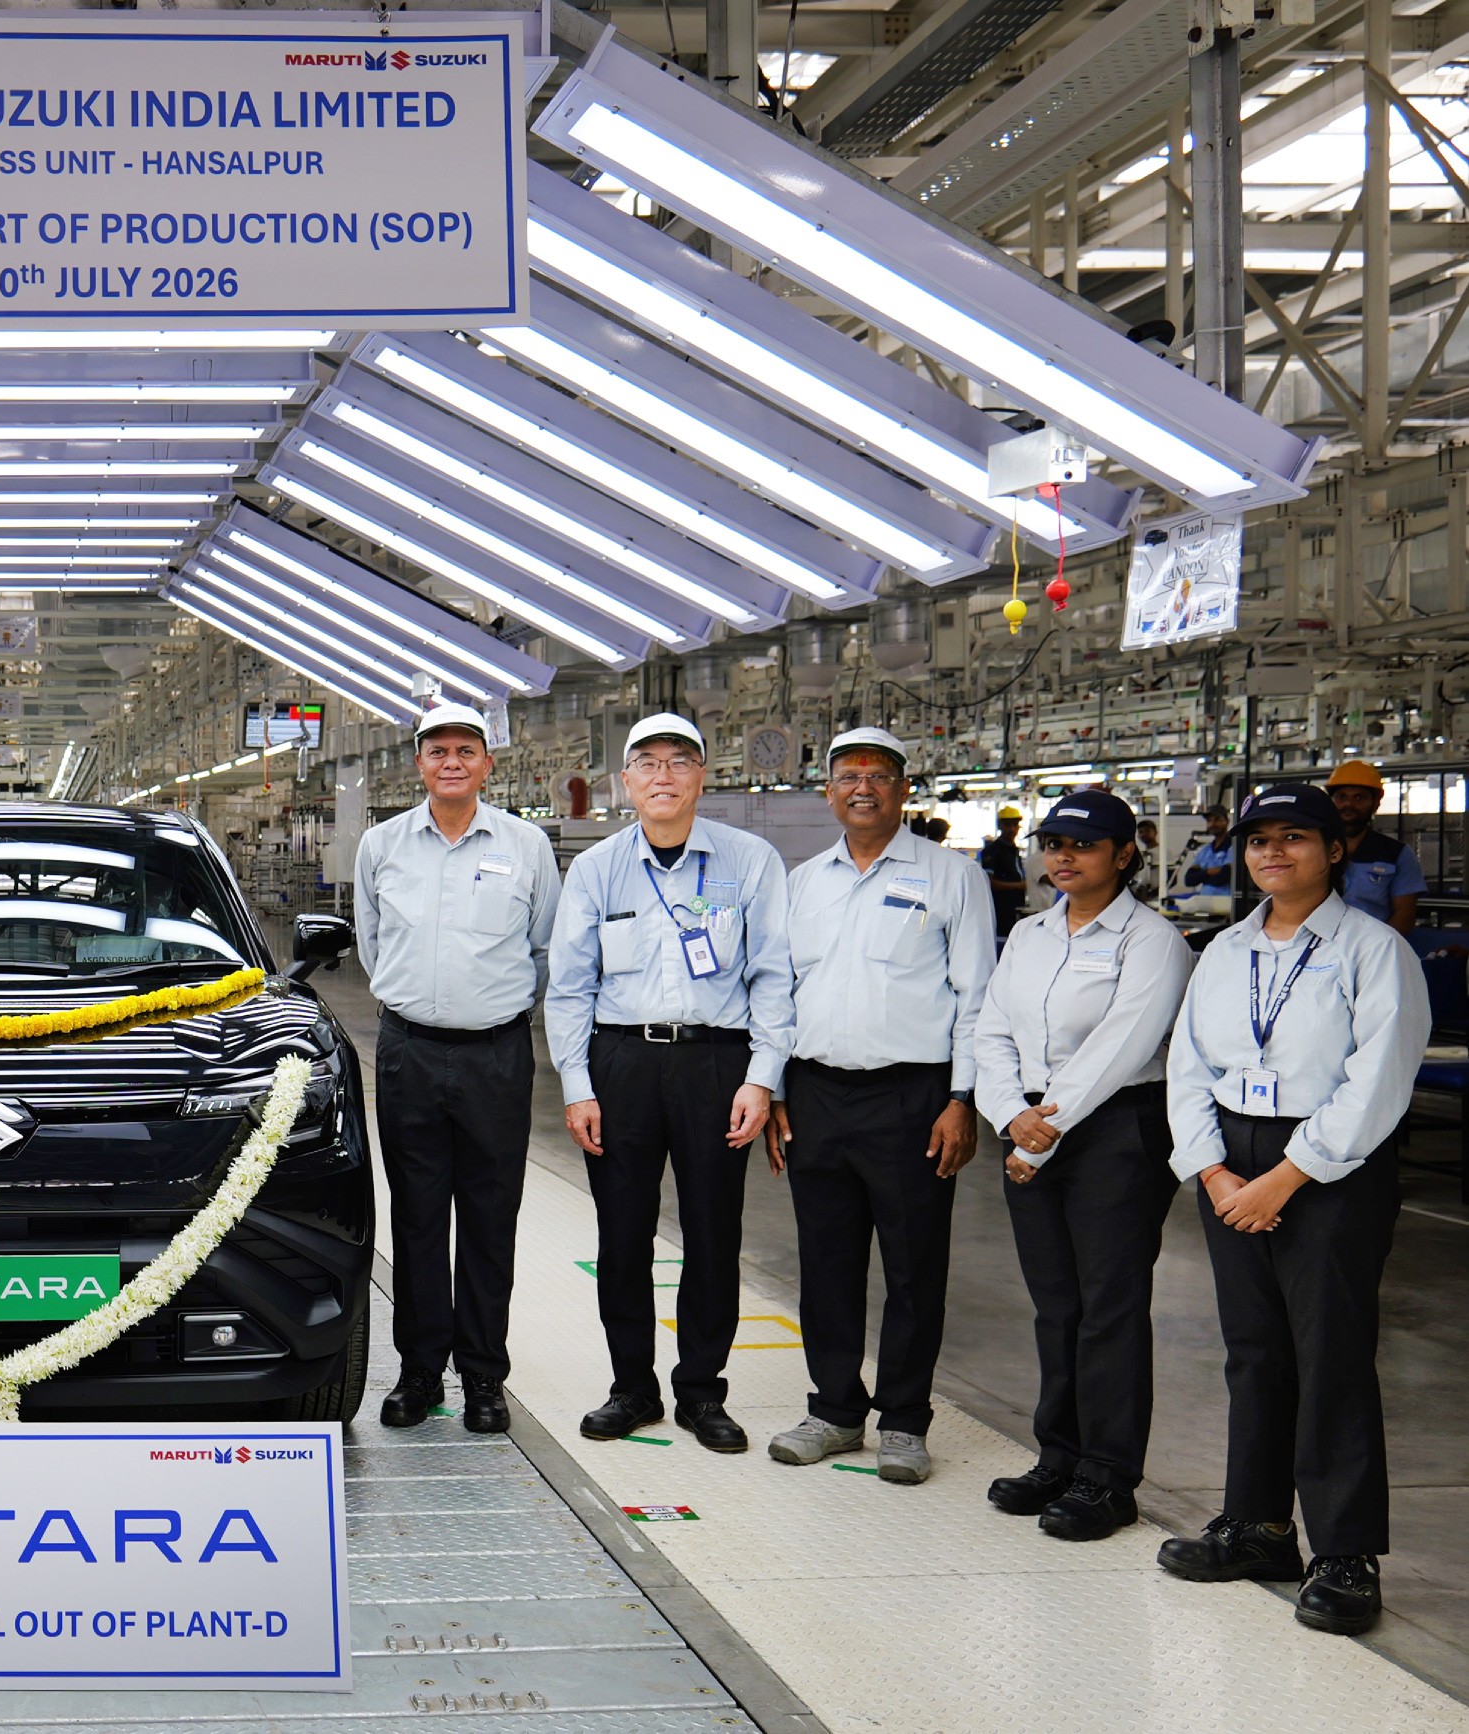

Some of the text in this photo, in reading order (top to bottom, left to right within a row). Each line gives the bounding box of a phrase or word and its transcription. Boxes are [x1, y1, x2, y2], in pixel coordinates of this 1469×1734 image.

[285, 54, 487, 66] MARUTI SUZUKI
[130, 90, 262, 129] INDIA
[273, 90, 457, 129] LIMITED
[45, 150, 116, 176] UNIT
[142, 150, 325, 176] HANSALPUR
[38, 213, 91, 246] OF
[100, 213, 359, 246] PRODUCTION
[369, 212, 474, 253] (SOP)
[54, 267, 142, 300] JULY
[150, 267, 239, 299] 2026
[1178, 519, 1206, 540] Thank
[150, 1450, 314, 1461] MARUTI SUZUKI
[13, 1609, 85, 1639] OUT
[91, 1609, 138, 1639] OF
[145, 1609, 289, 1639] PLANT-D
